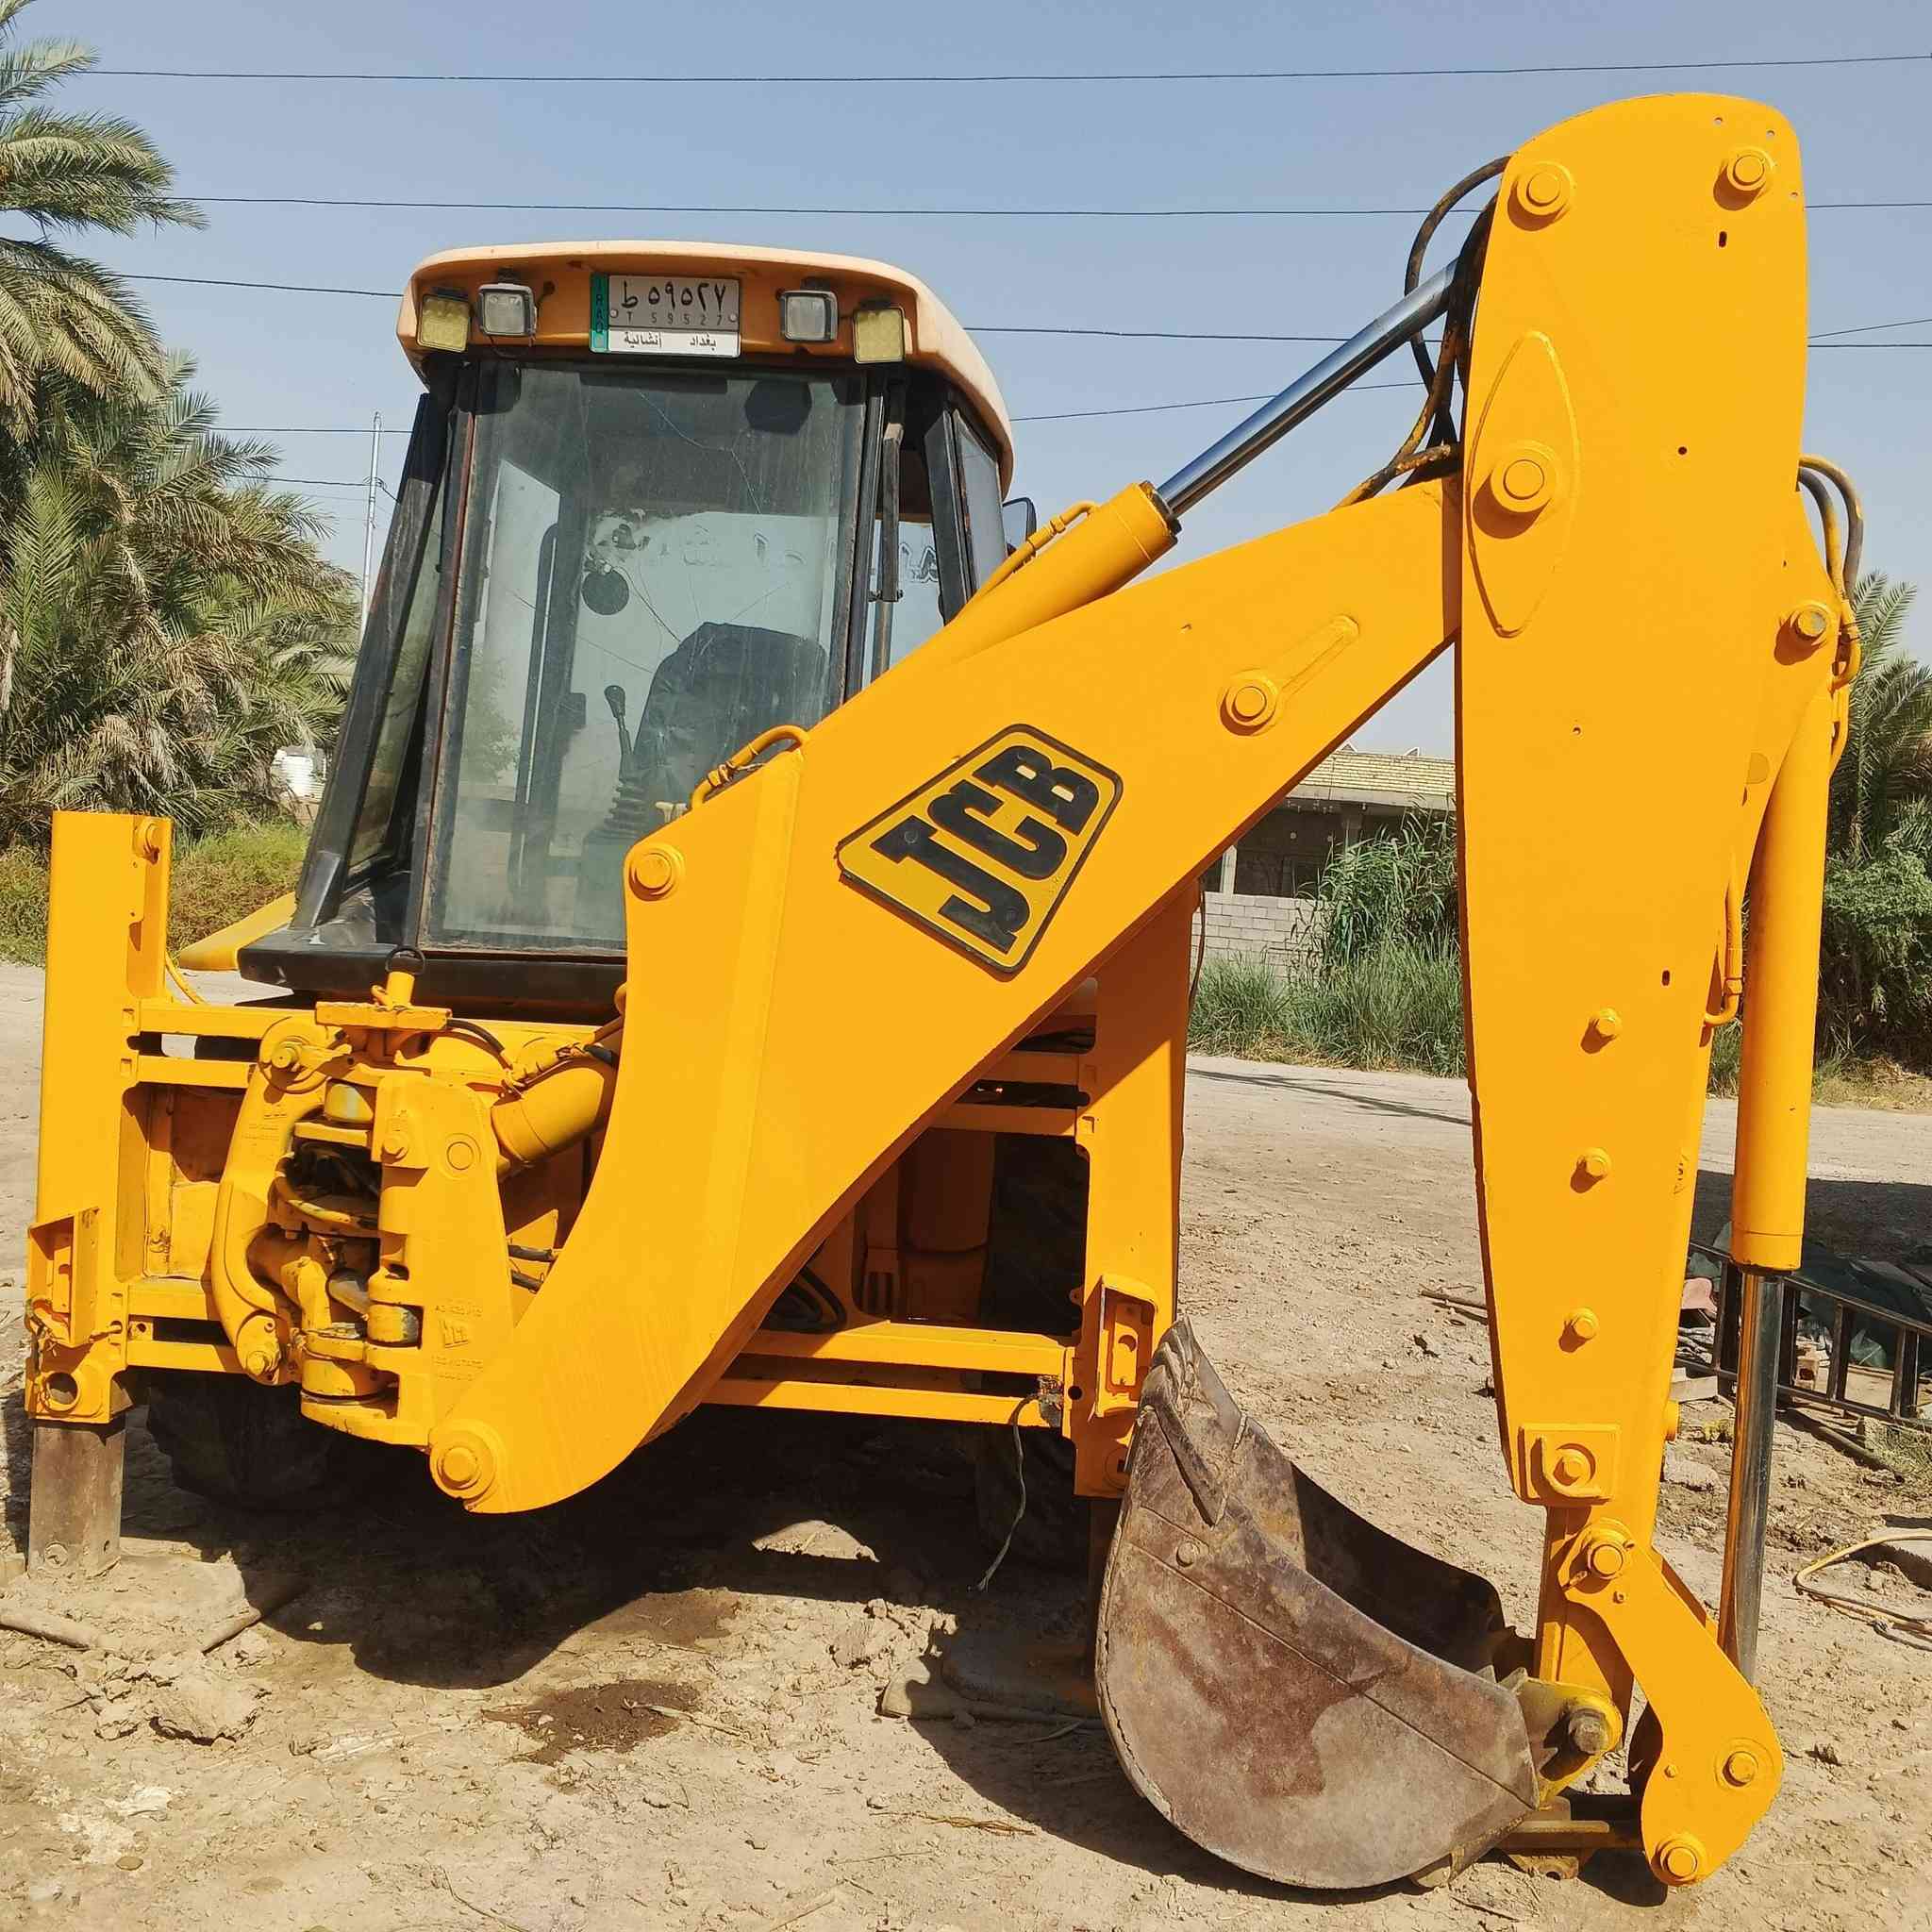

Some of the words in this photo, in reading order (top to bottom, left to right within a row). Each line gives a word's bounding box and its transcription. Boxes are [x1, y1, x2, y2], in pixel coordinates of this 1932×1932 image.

[621, 279, 639, 308] ط
[626, 311, 634, 323] T
[651, 312, 723, 325] 59527
[690, 332, 717, 351] بغداد
[869, 745, 1100, 955] JCB
